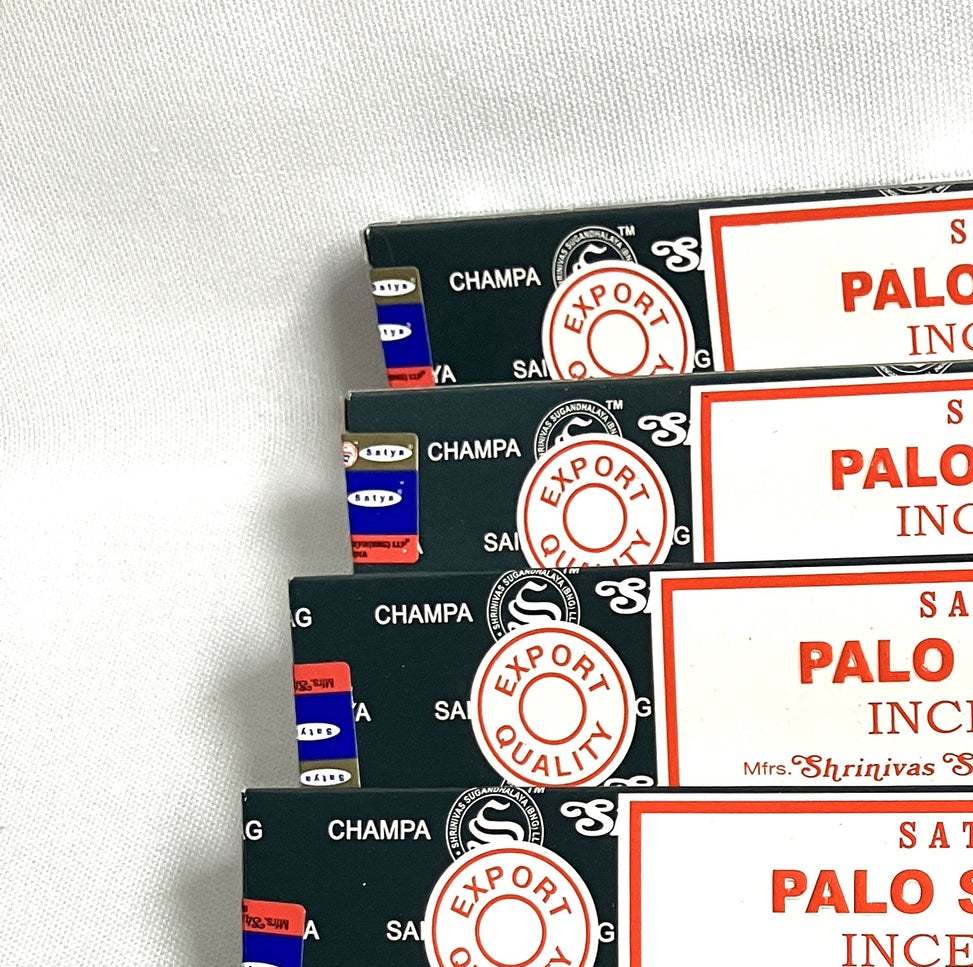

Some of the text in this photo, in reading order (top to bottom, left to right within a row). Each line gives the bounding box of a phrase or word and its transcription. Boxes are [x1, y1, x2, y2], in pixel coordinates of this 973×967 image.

[450, 267, 541, 291] CHAMPA
[564, 283, 669, 338] EXPORT
[428, 439, 521, 461] CHAMPA
[540, 456, 649, 512] EXPORT
[375, 603, 473, 624] CHAMPA
[495, 644, 609, 701] EXPORT
[799, 638, 954, 684] PALO
[496, 717, 611, 777] QUALITY
[744, 762, 791, 775] Mfrs.
[791, 755, 935, 782] Shrinivas
[329, 820, 431, 840] CHAMPA
[451, 866, 571, 923] EXPORT
[772, 869, 934, 914] PALO
